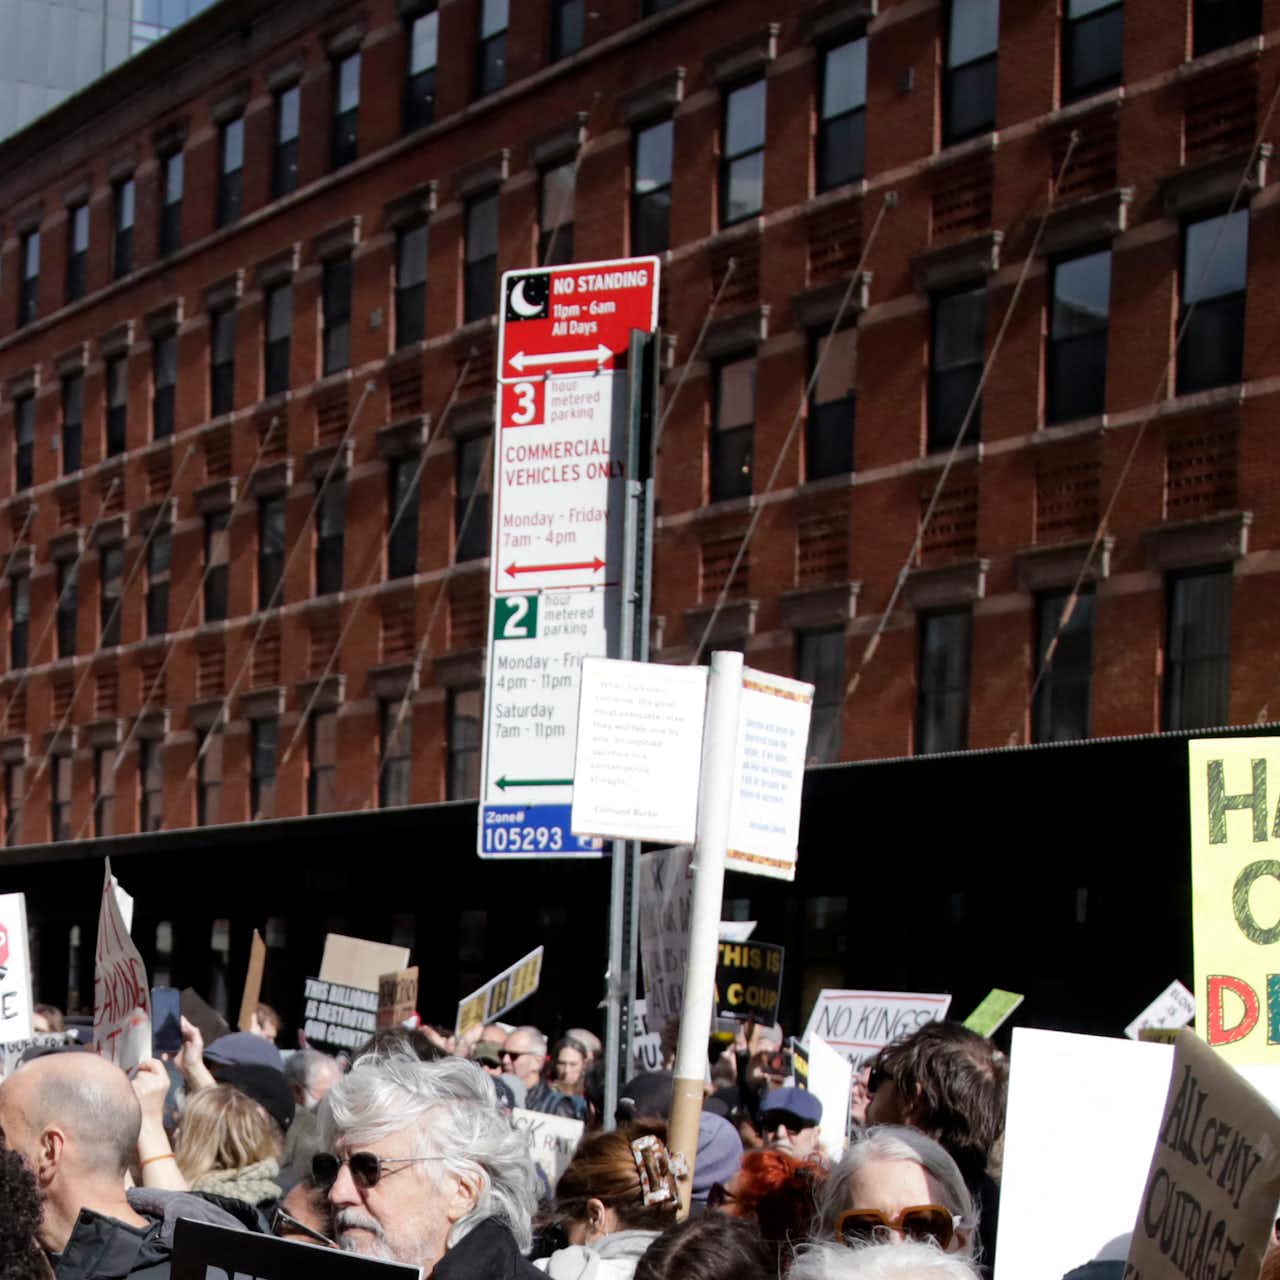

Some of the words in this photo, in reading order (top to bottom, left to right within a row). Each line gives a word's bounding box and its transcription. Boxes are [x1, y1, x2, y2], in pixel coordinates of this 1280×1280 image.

[553, 277, 575, 295] NO
[578, 270, 648, 292] STANDING
[553, 304, 580, 319] 11pm
[589, 301, 616, 315] 6am
[552, 321, 569, 336] All
[570, 320, 598, 336] Days
[551, 380, 577, 392] hour
[511, 382, 536, 424] 3
[551, 390, 600, 405] metered
[550, 407, 594, 423] parking
[506, 438, 610, 463] COMMERCIAL
[506, 464, 580, 487] VEHICLES
[503, 511, 555, 528] Monday
[504, 533, 531, 547] 7am
[545, 530, 576, 547] 4pm
[544, 594, 571, 606] hour
[503, 596, 529, 638] 2
[544, 607, 595, 621] metered
[543, 623, 587, 637] parking
[497, 655, 548, 672] Monday
[497, 675, 527, 692] 4pm
[541, 673, 572, 689] 11pm
[496, 704, 554, 719] Saturday
[496, 724, 521, 739] 7am
[535, 723, 565, 739] 11pm
[485, 810, 526, 824] Zone#
[485, 827, 563, 850] 105293
[766, 951, 781, 971] IS
[726, 983, 777, 1008] COUP
[816, 1005, 853, 1038] NO
[1159, 1065, 1208, 1166] ALL
[1217, 1130, 1262, 1210] MY
